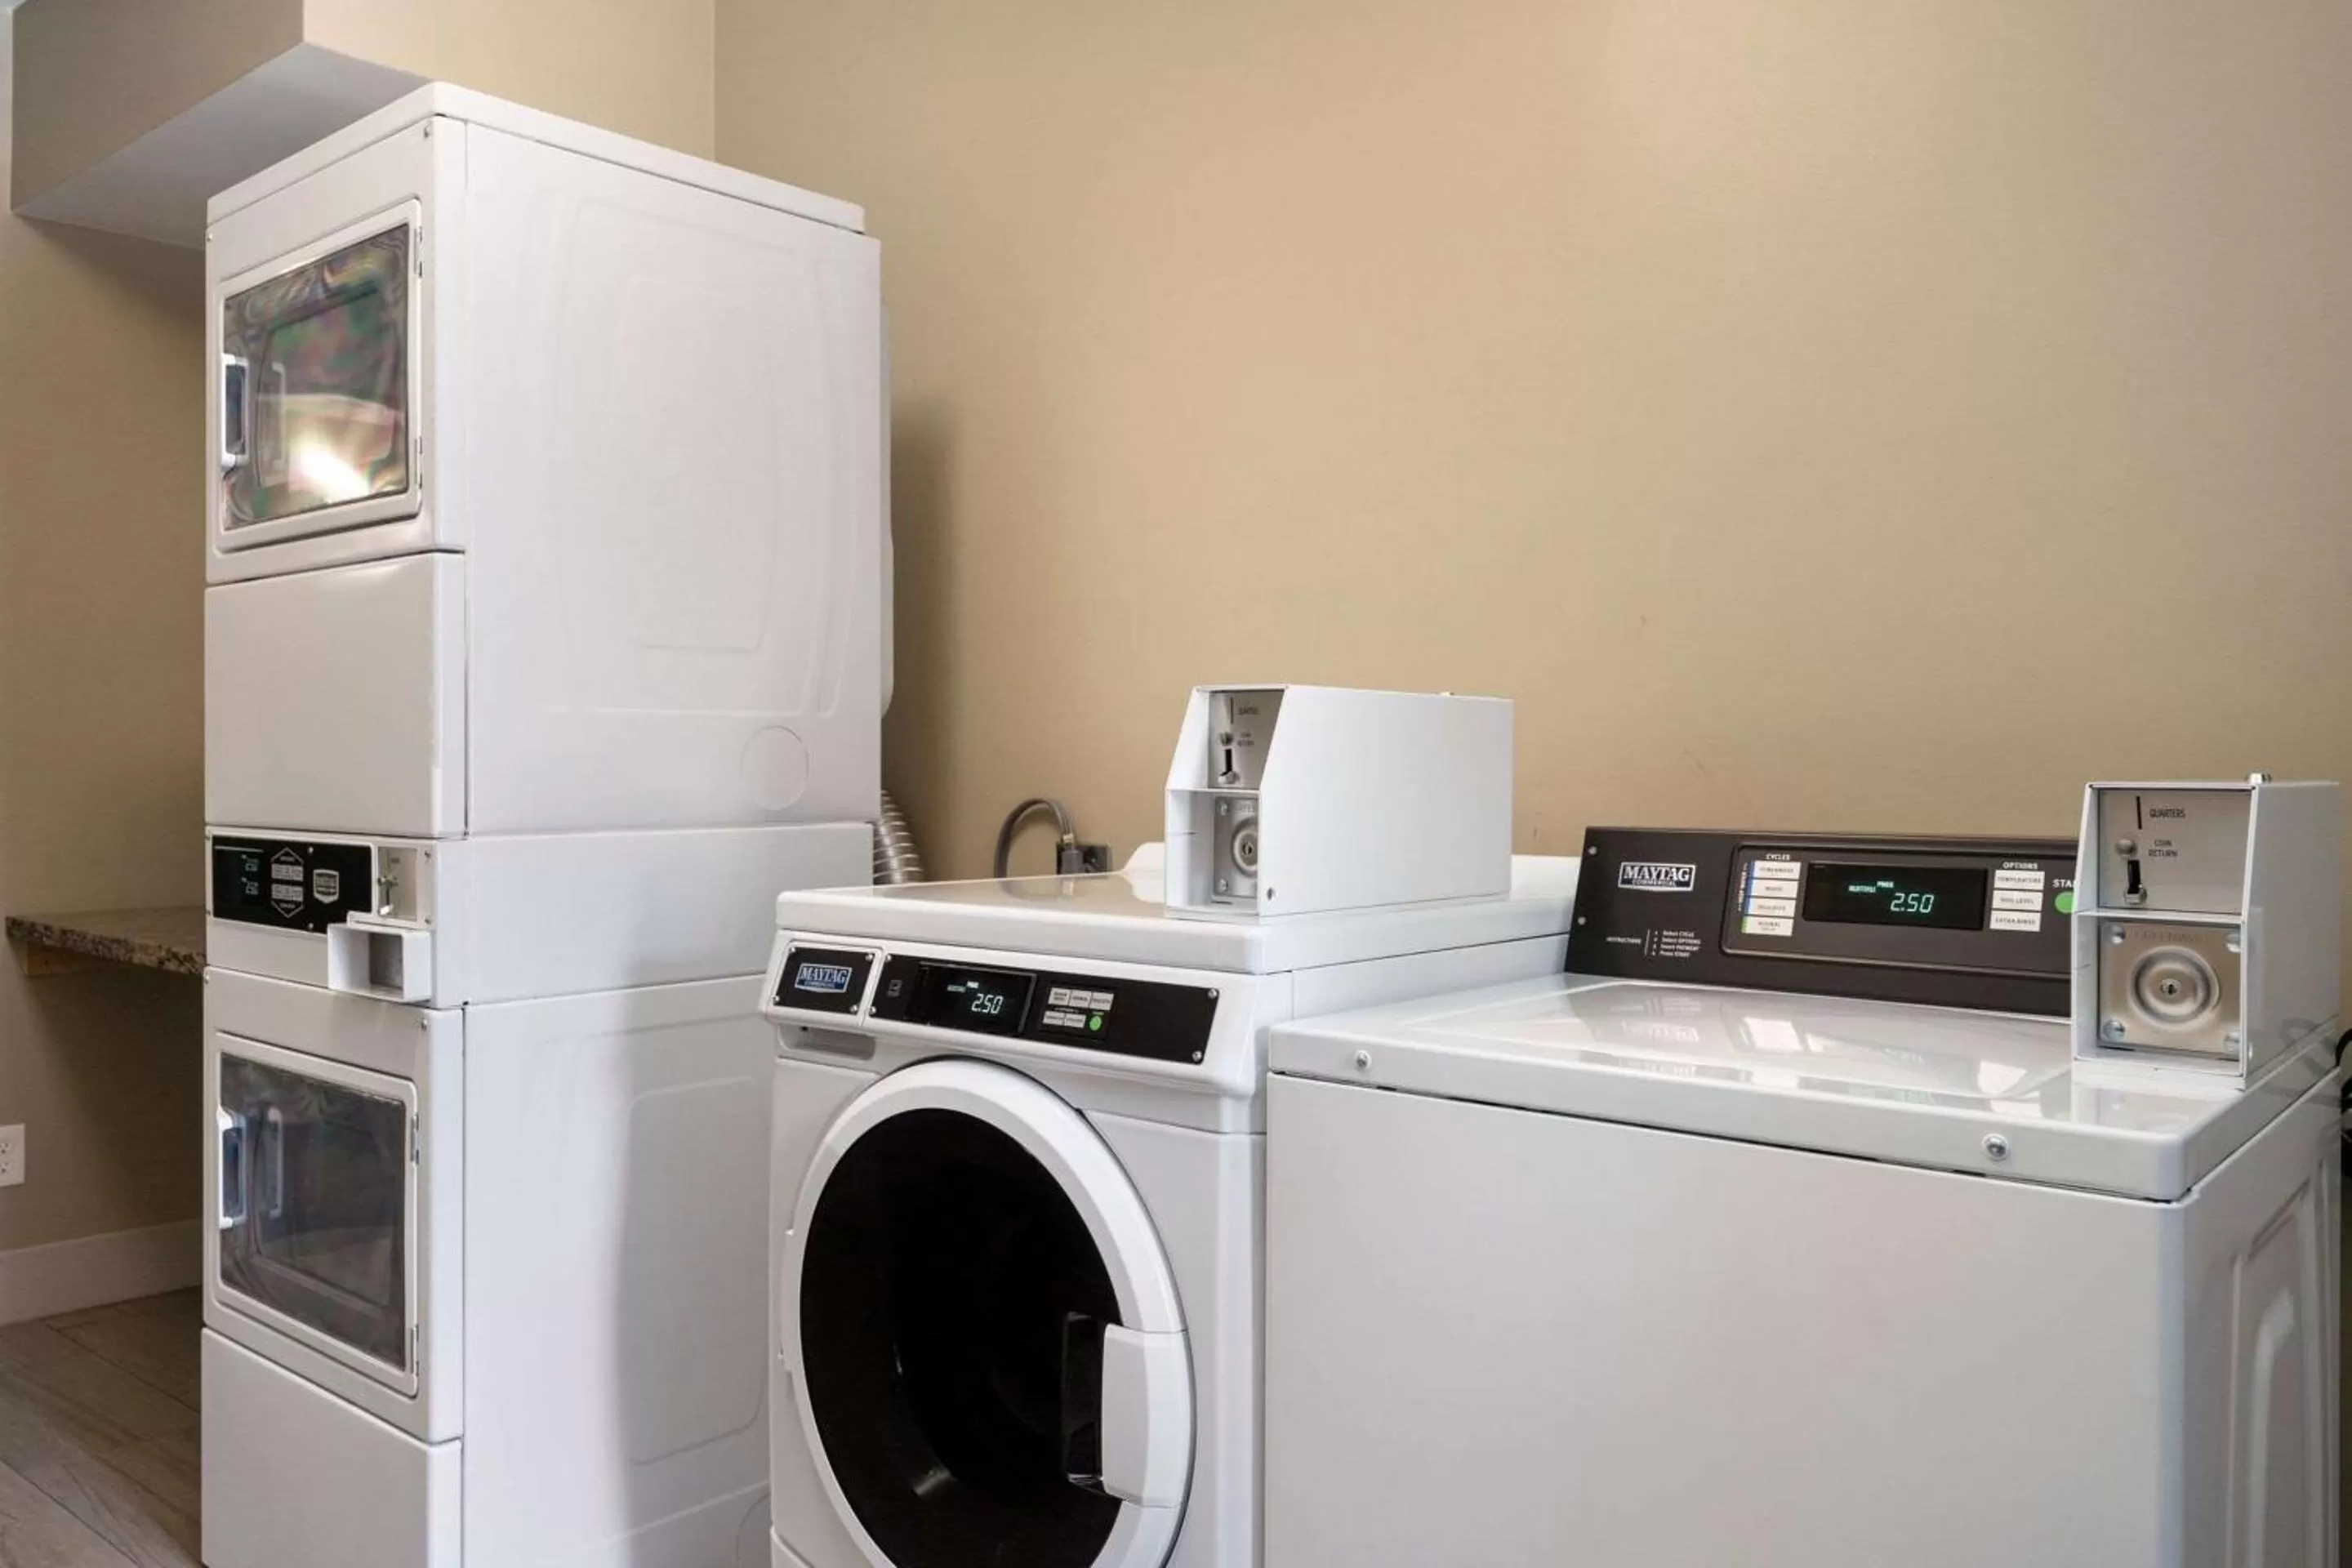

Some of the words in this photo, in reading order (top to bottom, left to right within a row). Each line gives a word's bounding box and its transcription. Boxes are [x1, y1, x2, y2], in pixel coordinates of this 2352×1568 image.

[2149, 808, 2186, 818] QUARTERS
[2154, 839, 2172, 847] COIN
[2148, 849, 2178, 857] RETURN
[2002, 862, 2038, 870] OPTIONS
[1624, 865, 1690, 882] MAYTAG
[1890, 892, 1935, 913] 2.50
[800, 966, 848, 984] MAYTAG
[971, 993, 1004, 1013] 2.50
